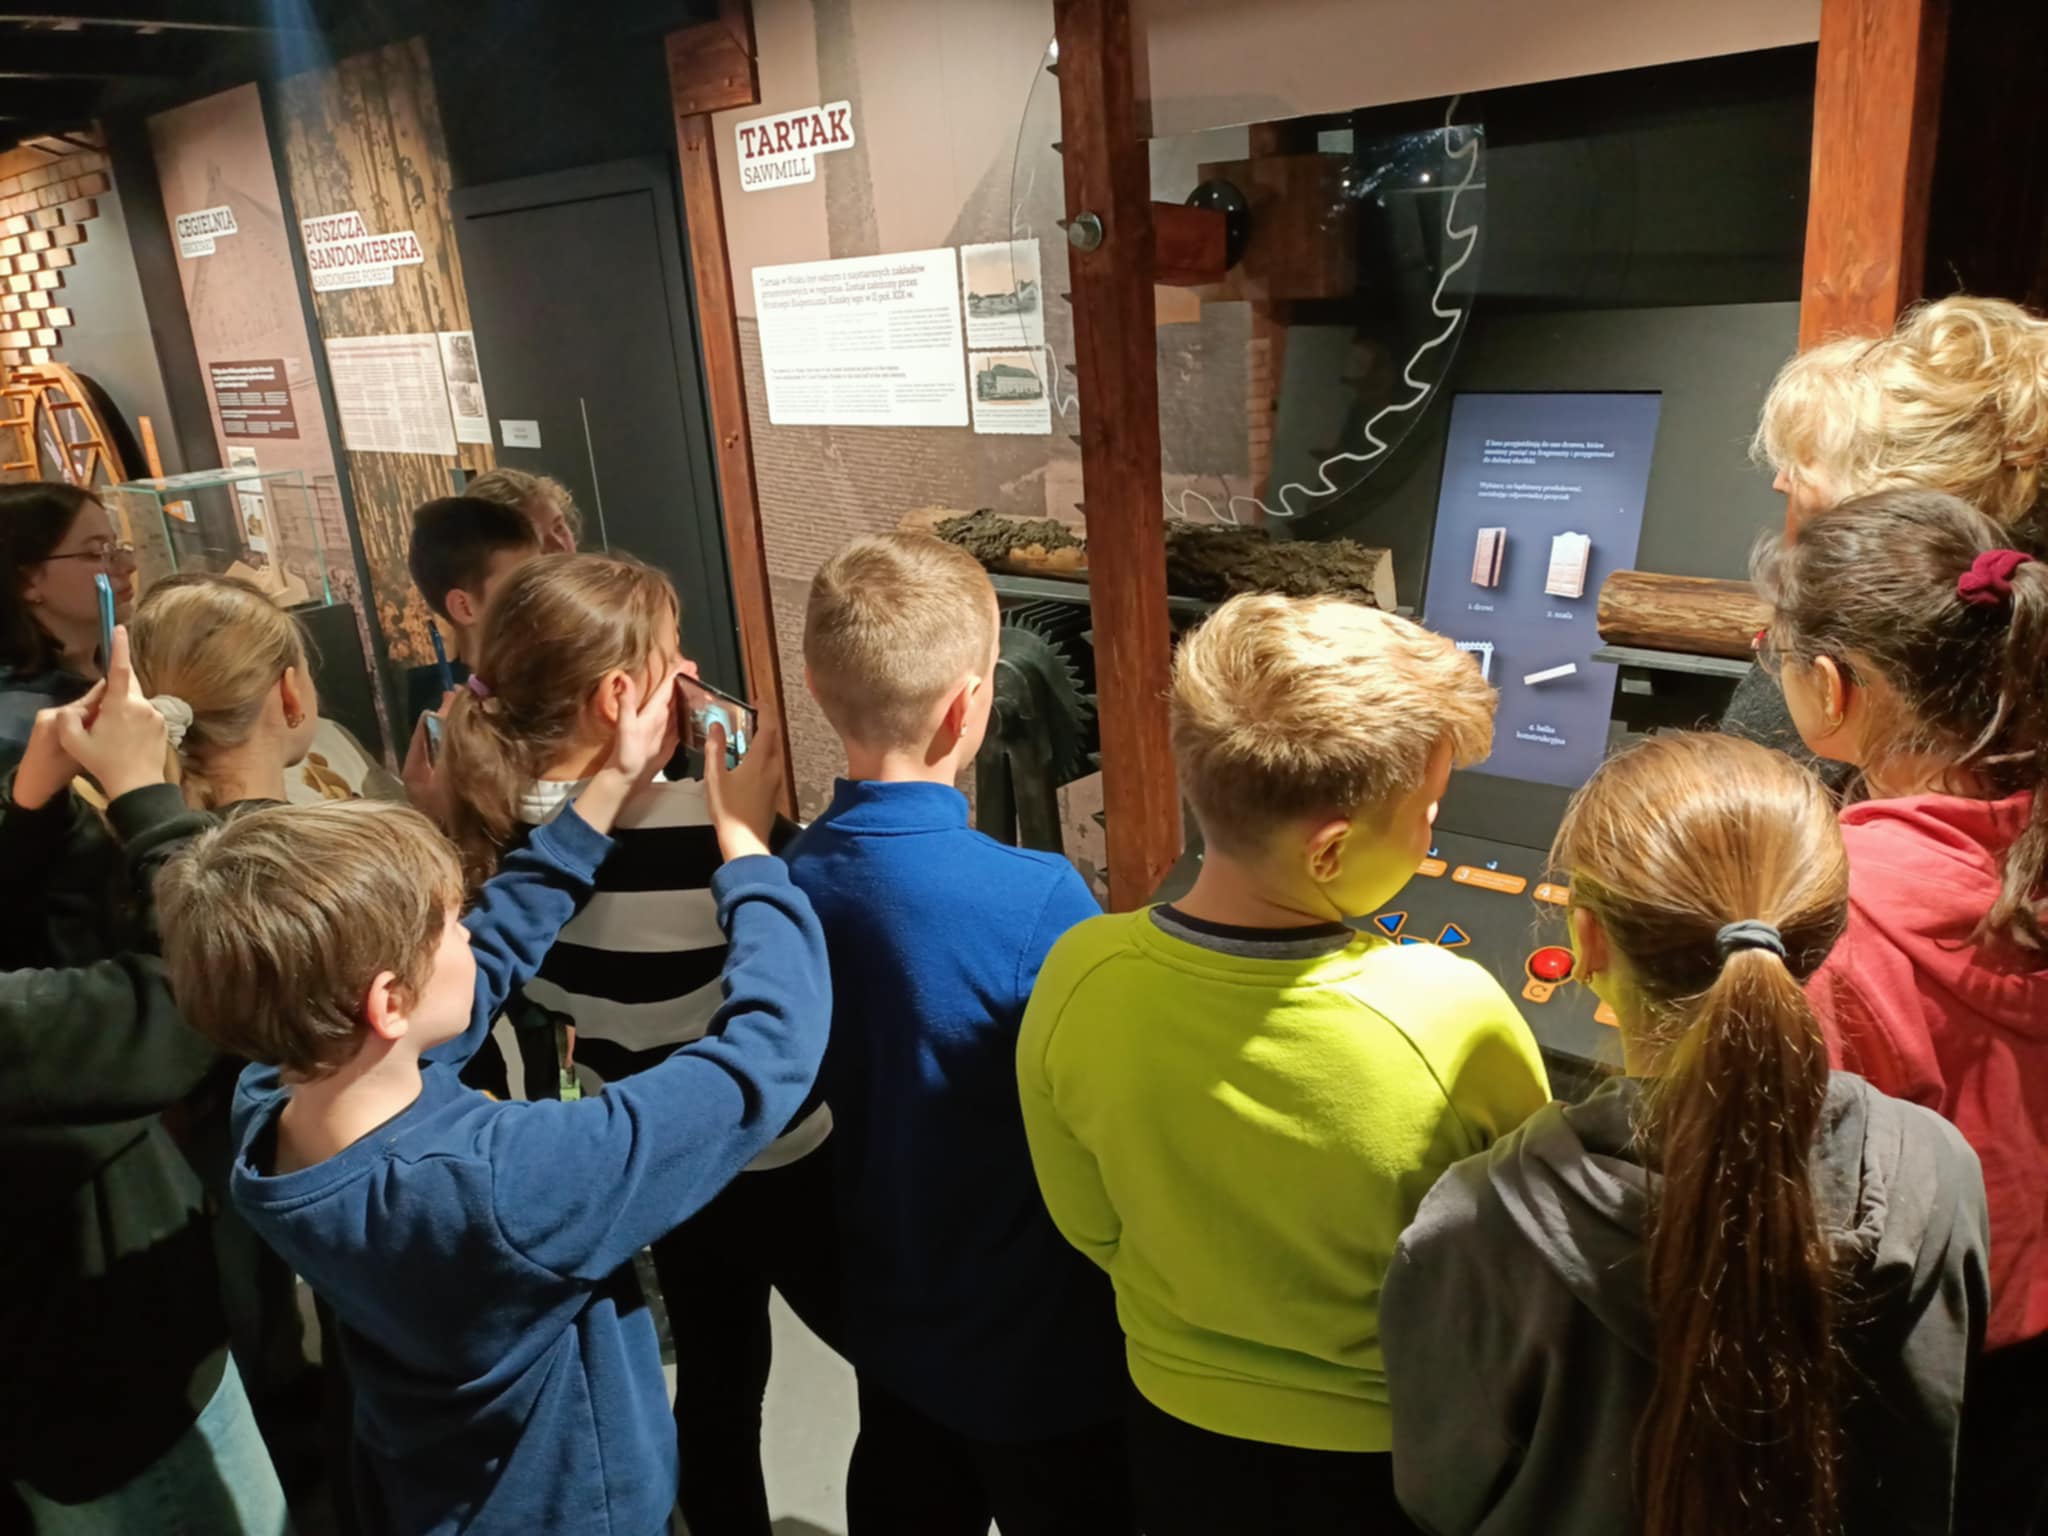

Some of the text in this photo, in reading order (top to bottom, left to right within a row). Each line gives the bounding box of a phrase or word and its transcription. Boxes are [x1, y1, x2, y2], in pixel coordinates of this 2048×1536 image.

[740, 108, 849, 158] TARTAK
[744, 158, 811, 185] SAWMILL
[177, 210, 236, 238] CEGIELNIA
[304, 216, 365, 244] PUSZCZA
[310, 236, 421, 270] SANDOMIERSKA
[1459, 868, 1470, 880] 3
